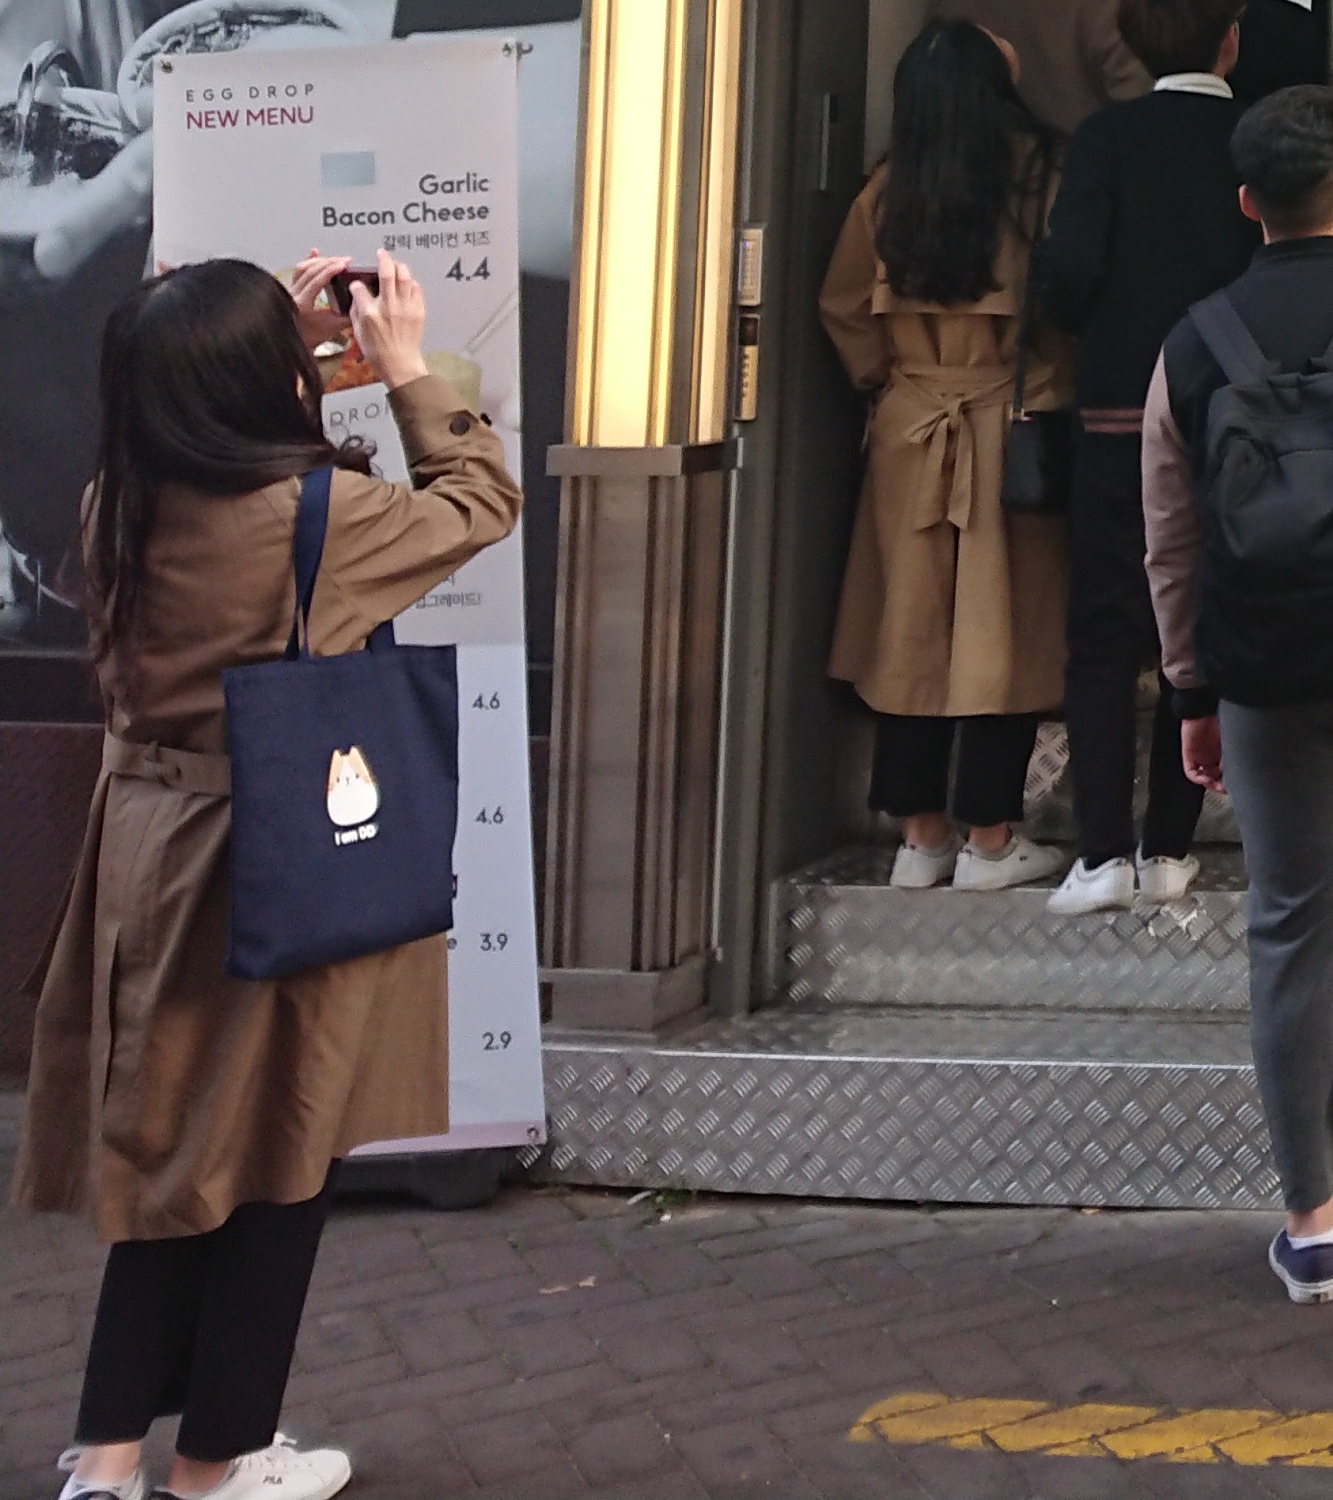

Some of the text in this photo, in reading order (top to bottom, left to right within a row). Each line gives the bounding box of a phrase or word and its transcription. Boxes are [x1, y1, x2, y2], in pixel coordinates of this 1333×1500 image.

[186, 83, 314, 102] EGG DROP
[186, 106, 314, 130] NEW MENU
[418, 171, 490, 195] Garlic
[322, 201, 490, 227] Bacon Cheese
[383, 231, 491, 251] 갈릭 베이컨 치즈
[446, 257, 490, 281] 4.4
[330, 402, 390, 427] DRO
[472, 692, 500, 710] 4.6
[475, 806, 504, 824] 4.6
[480, 933, 508, 951] 3.9
[482, 1031, 511, 1051] 2.9
